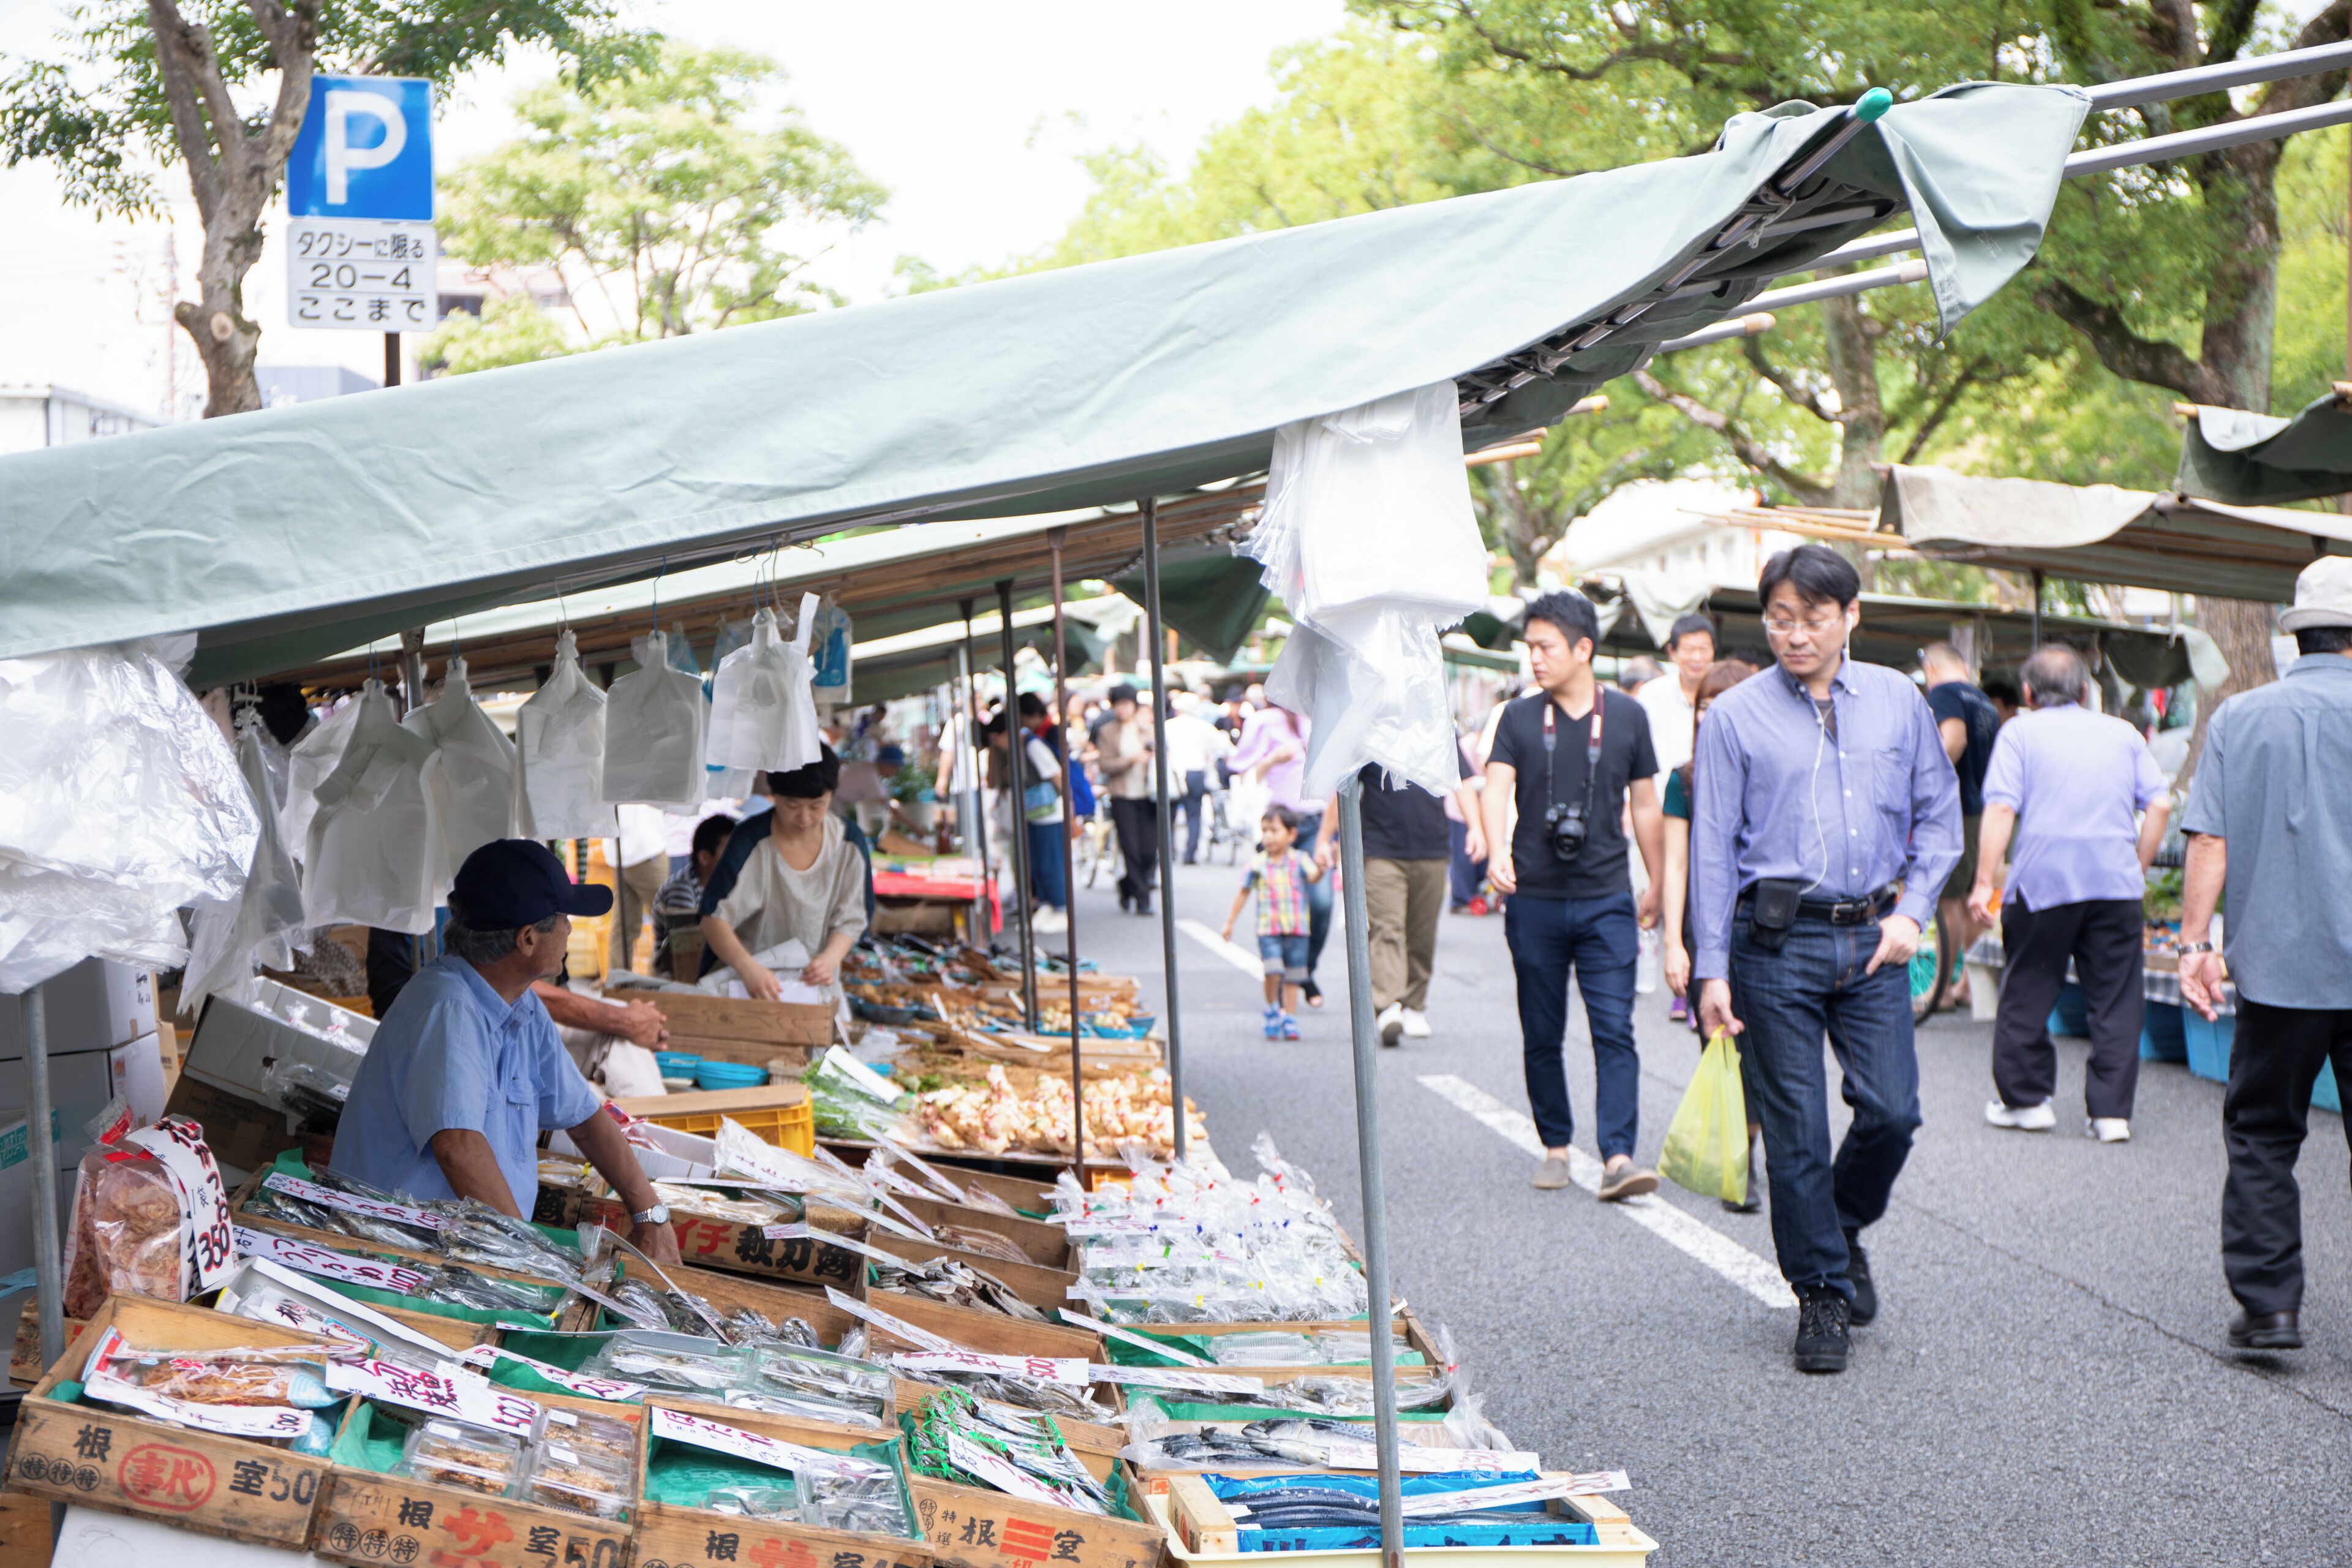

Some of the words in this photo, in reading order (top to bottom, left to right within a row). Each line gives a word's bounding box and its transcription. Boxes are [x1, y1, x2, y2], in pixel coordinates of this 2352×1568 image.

[325, 91, 407, 204] P
[298, 232, 424, 259] タクシーに限る
[299, 298, 425, 322] ここまで
[198, 1223, 230, 1273] 350
[1025, 1358, 1059, 1380] 500
[571, 1378, 629, 1398] 250
[265, 1413, 301, 1434] 500
[72, 1423, 113, 1463] 根
[228, 1460, 269, 1496] 室
[269, 1465, 317, 1506] 50
[397, 1496, 434, 1530] 根
[524, 1526, 562, 1558] 室
[935, 1509, 957, 1547] 特選
[957, 1516, 997, 1548] 根
[1050, 1529, 1085, 1564] 室
[704, 1529, 740, 1562] 根
